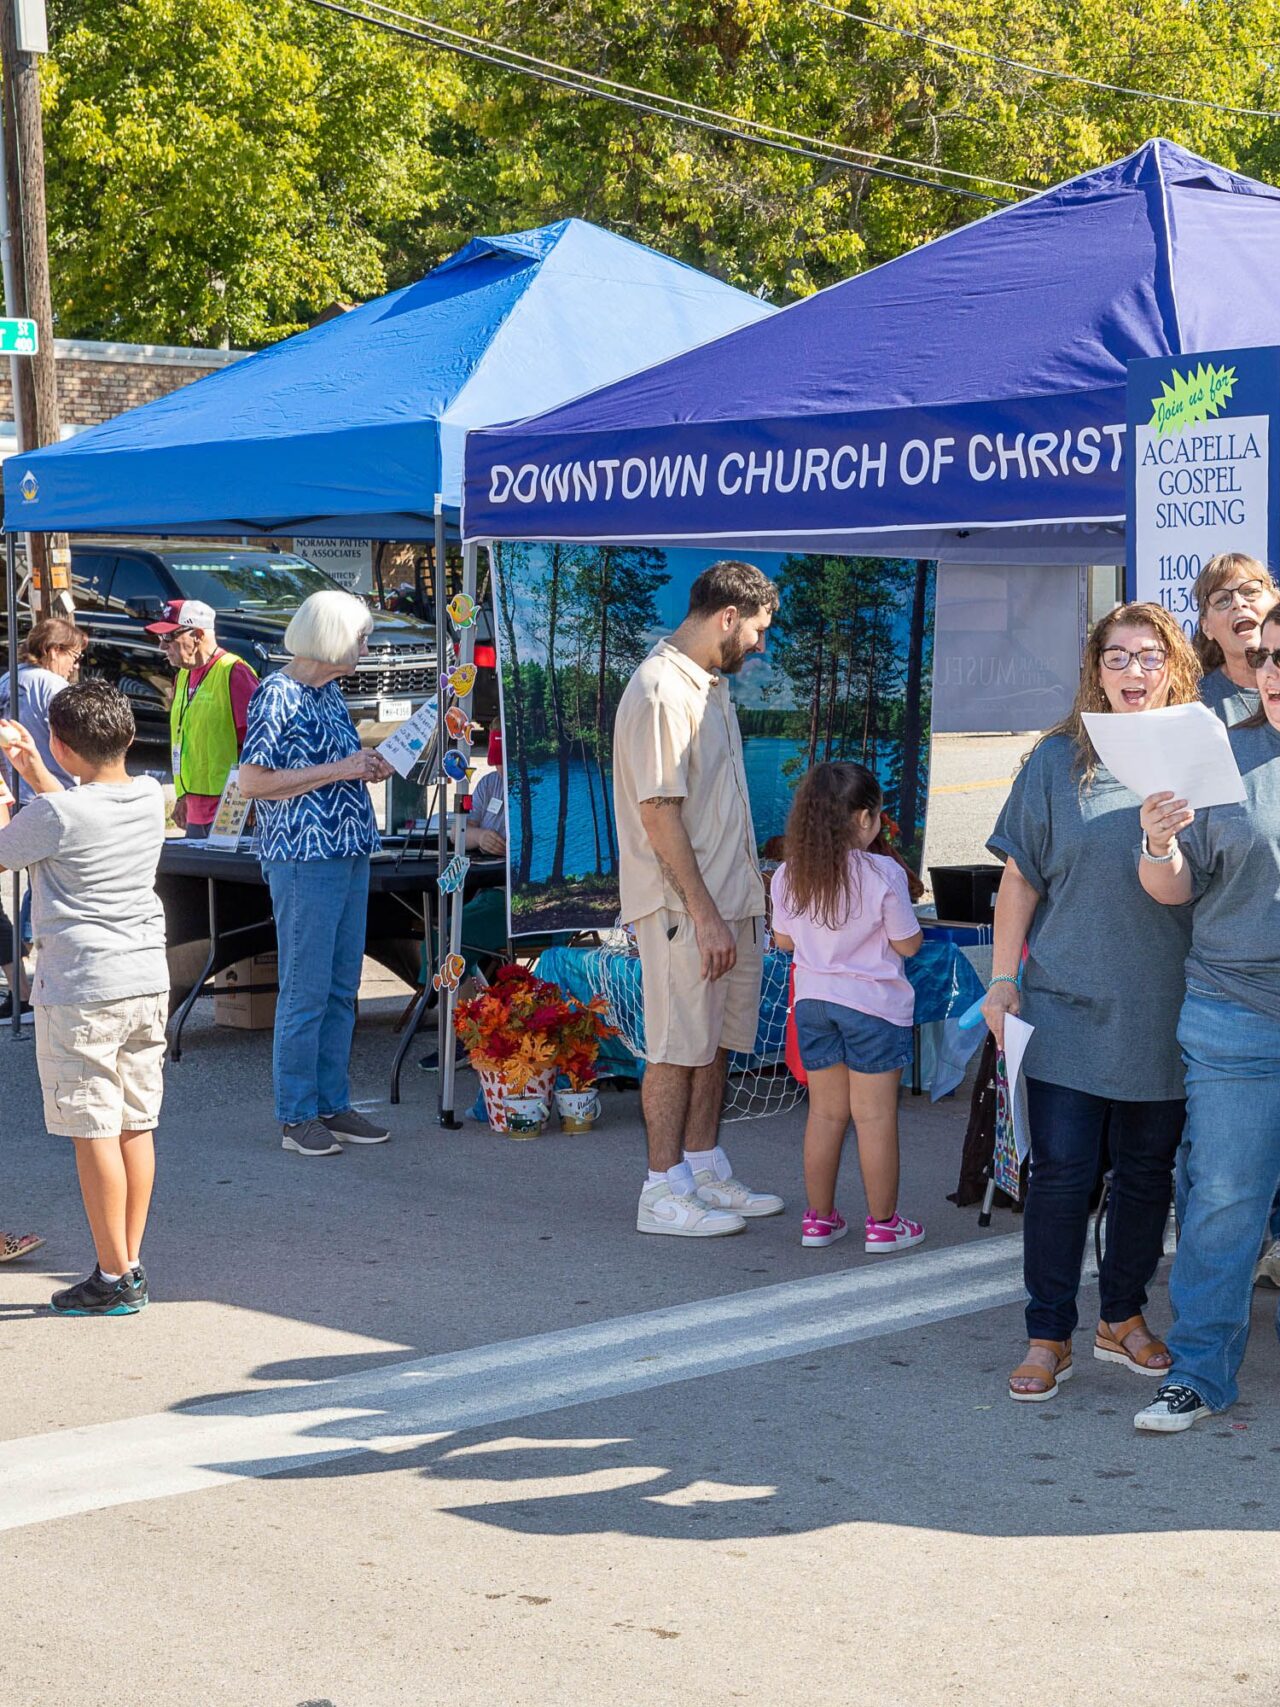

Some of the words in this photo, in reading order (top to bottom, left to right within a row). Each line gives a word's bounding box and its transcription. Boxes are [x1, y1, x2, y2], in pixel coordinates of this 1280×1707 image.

[17, 321, 29, 336] St
[1158, 401, 1184, 433] Join
[1189, 388, 1205, 406] us
[1210, 374, 1230, 402] for
[489, 453, 708, 503] DOWNTOWN
[717, 441, 888, 495] CHURCH
[899, 437, 955, 485] OF
[968, 423, 1127, 481] CHRIST
[1141, 432, 1262, 466] ACAPELLA
[1158, 466, 1242, 496] GOSPEL
[1155, 498, 1246, 529] SINGING
[296, 538, 333, 548] NORMAN
[340, 539, 369, 548] PATTEN
[302, 549, 308, 558] &
[312, 549, 361, 558] ASSOCIATES
[1158, 553, 1201, 581] 11:00
